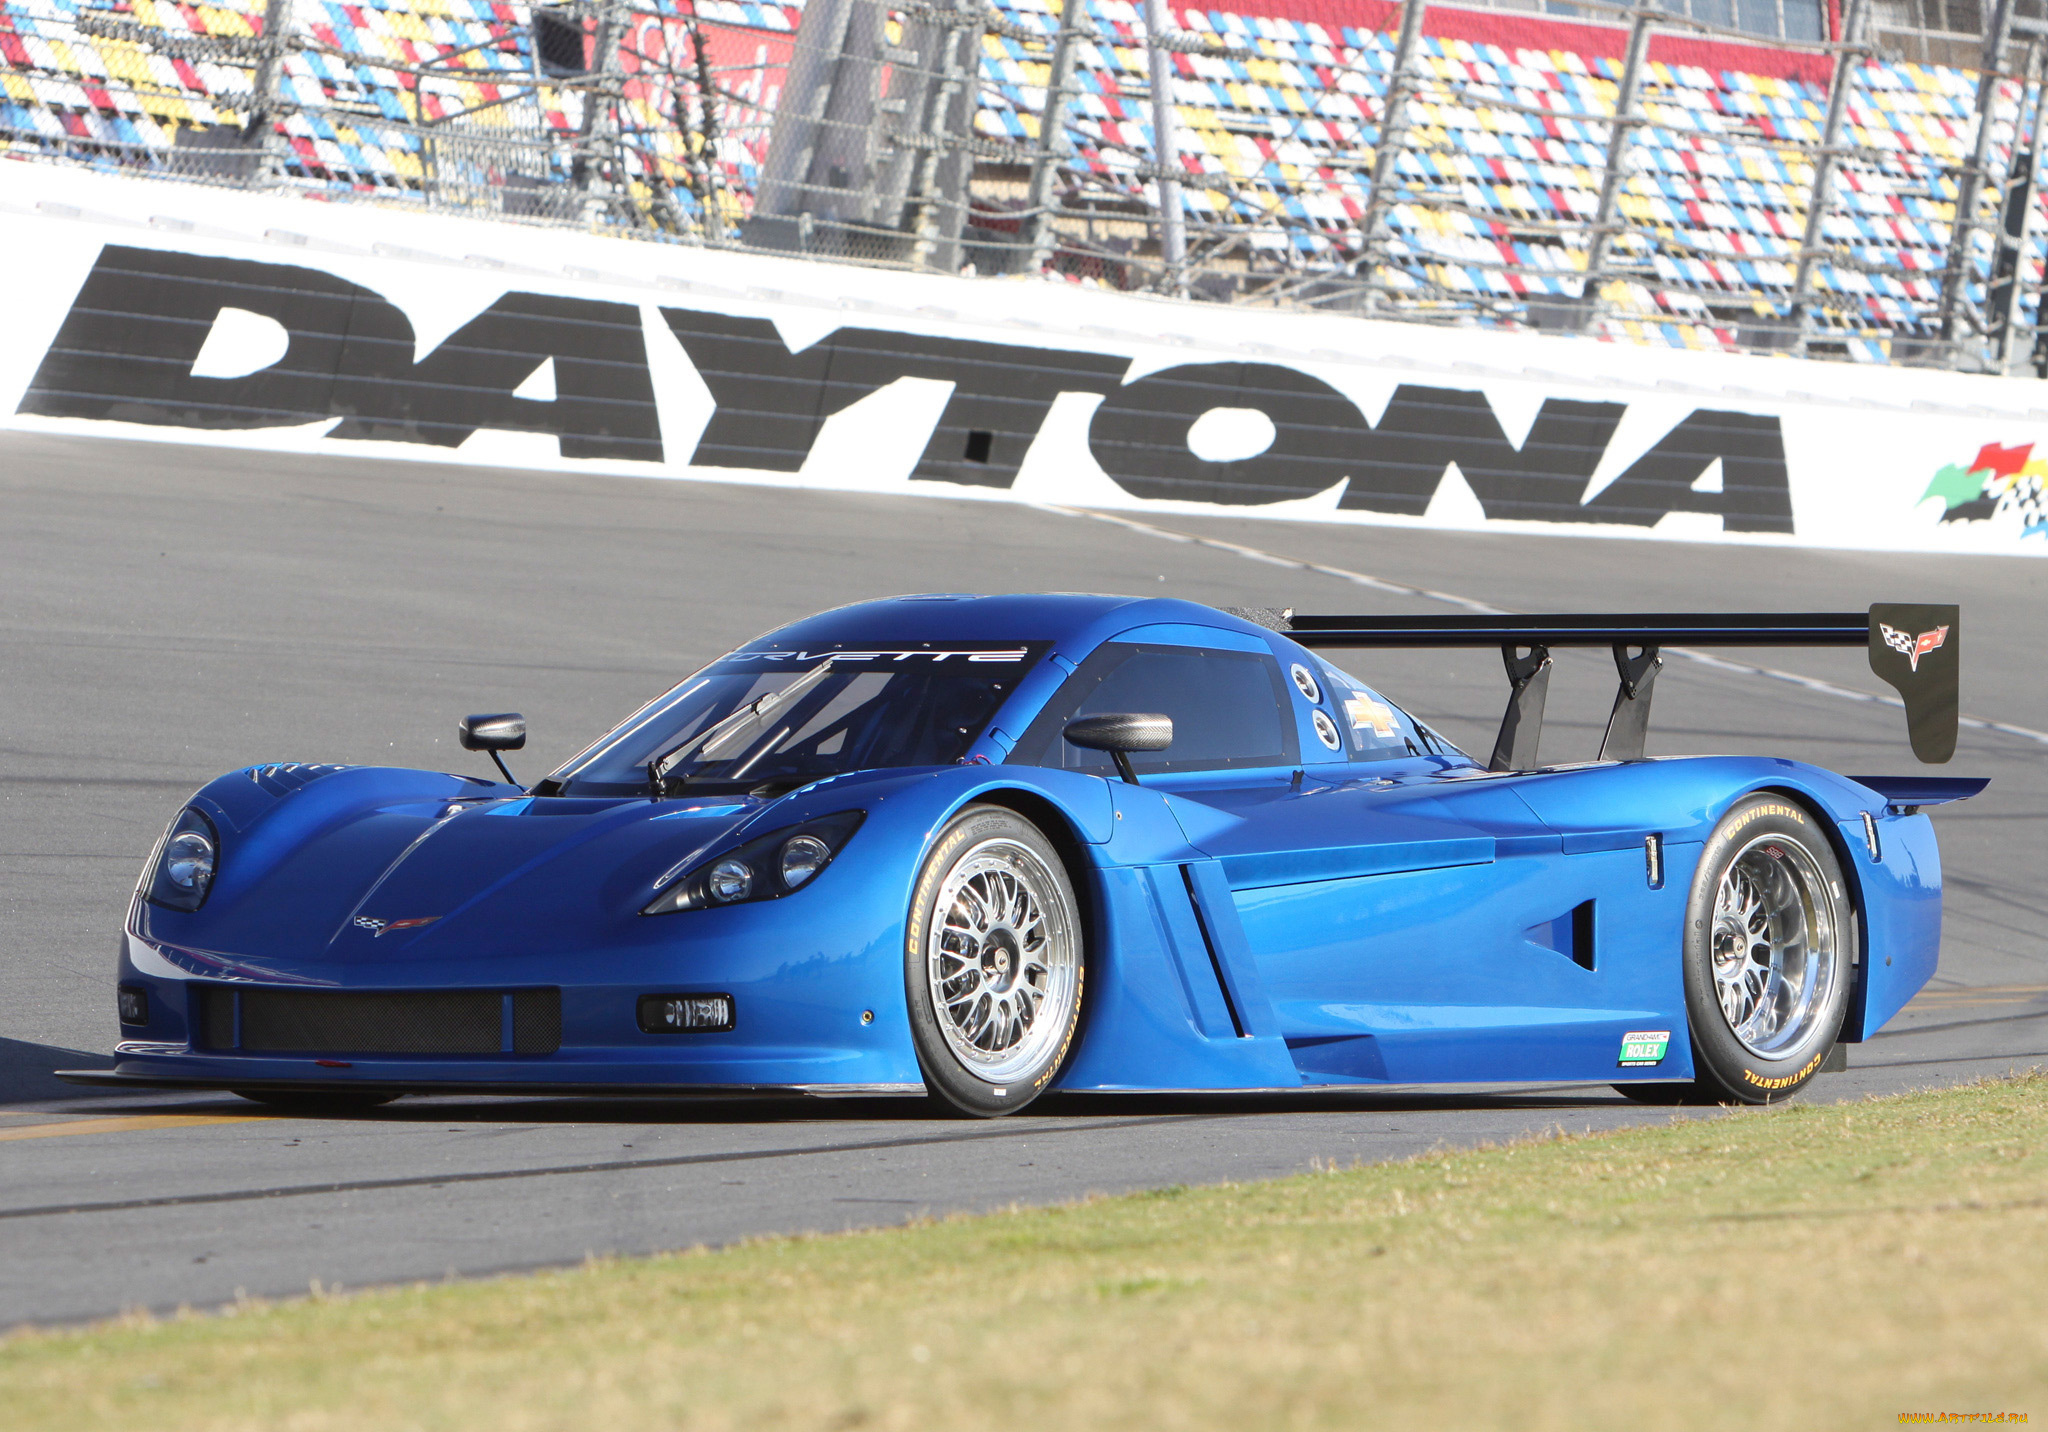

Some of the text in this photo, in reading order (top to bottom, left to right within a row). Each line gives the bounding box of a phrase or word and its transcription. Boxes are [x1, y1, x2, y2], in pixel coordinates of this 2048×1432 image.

[16, 244, 1794, 533] DAYTONA
[1726, 804, 1805, 840] CONTINENTAL
[908, 829, 965, 955] CONTINENTAL
[1626, 1043, 1659, 1057] ROLEX
[1744, 1052, 1821, 1089] CONTINENTAL
